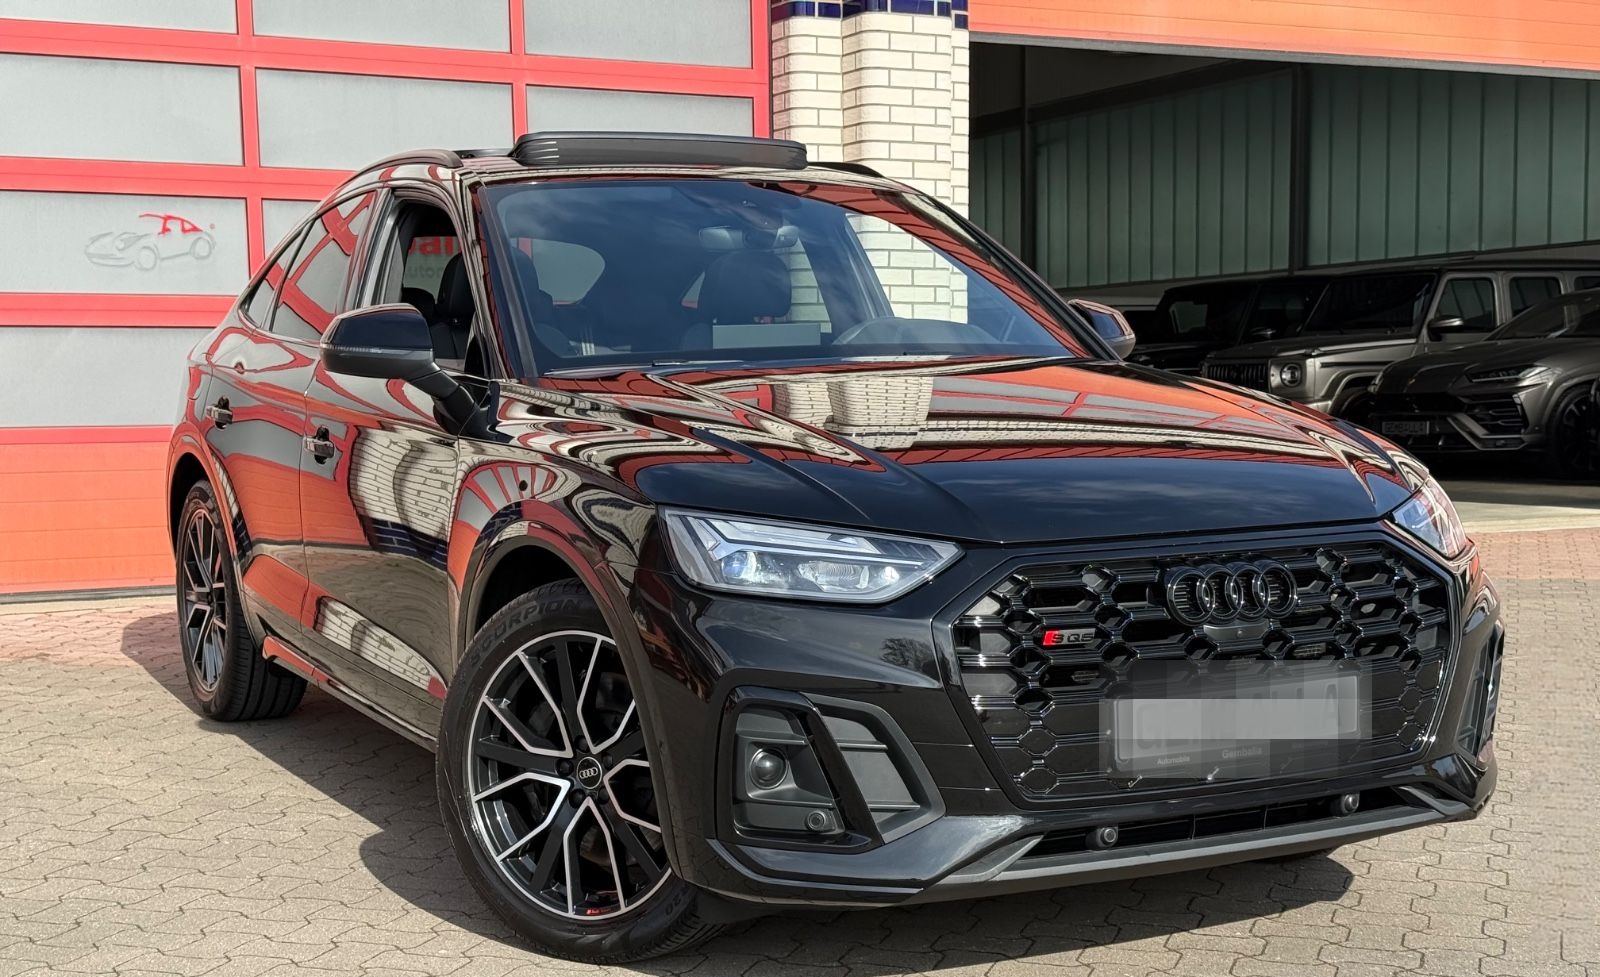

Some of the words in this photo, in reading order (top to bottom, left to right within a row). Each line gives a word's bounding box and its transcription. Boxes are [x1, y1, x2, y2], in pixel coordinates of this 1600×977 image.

[469, 599, 582, 666] SCORPION
[1156, 754, 1190, 766] Automobile
[1221, 746, 1263, 759] Gemballa
